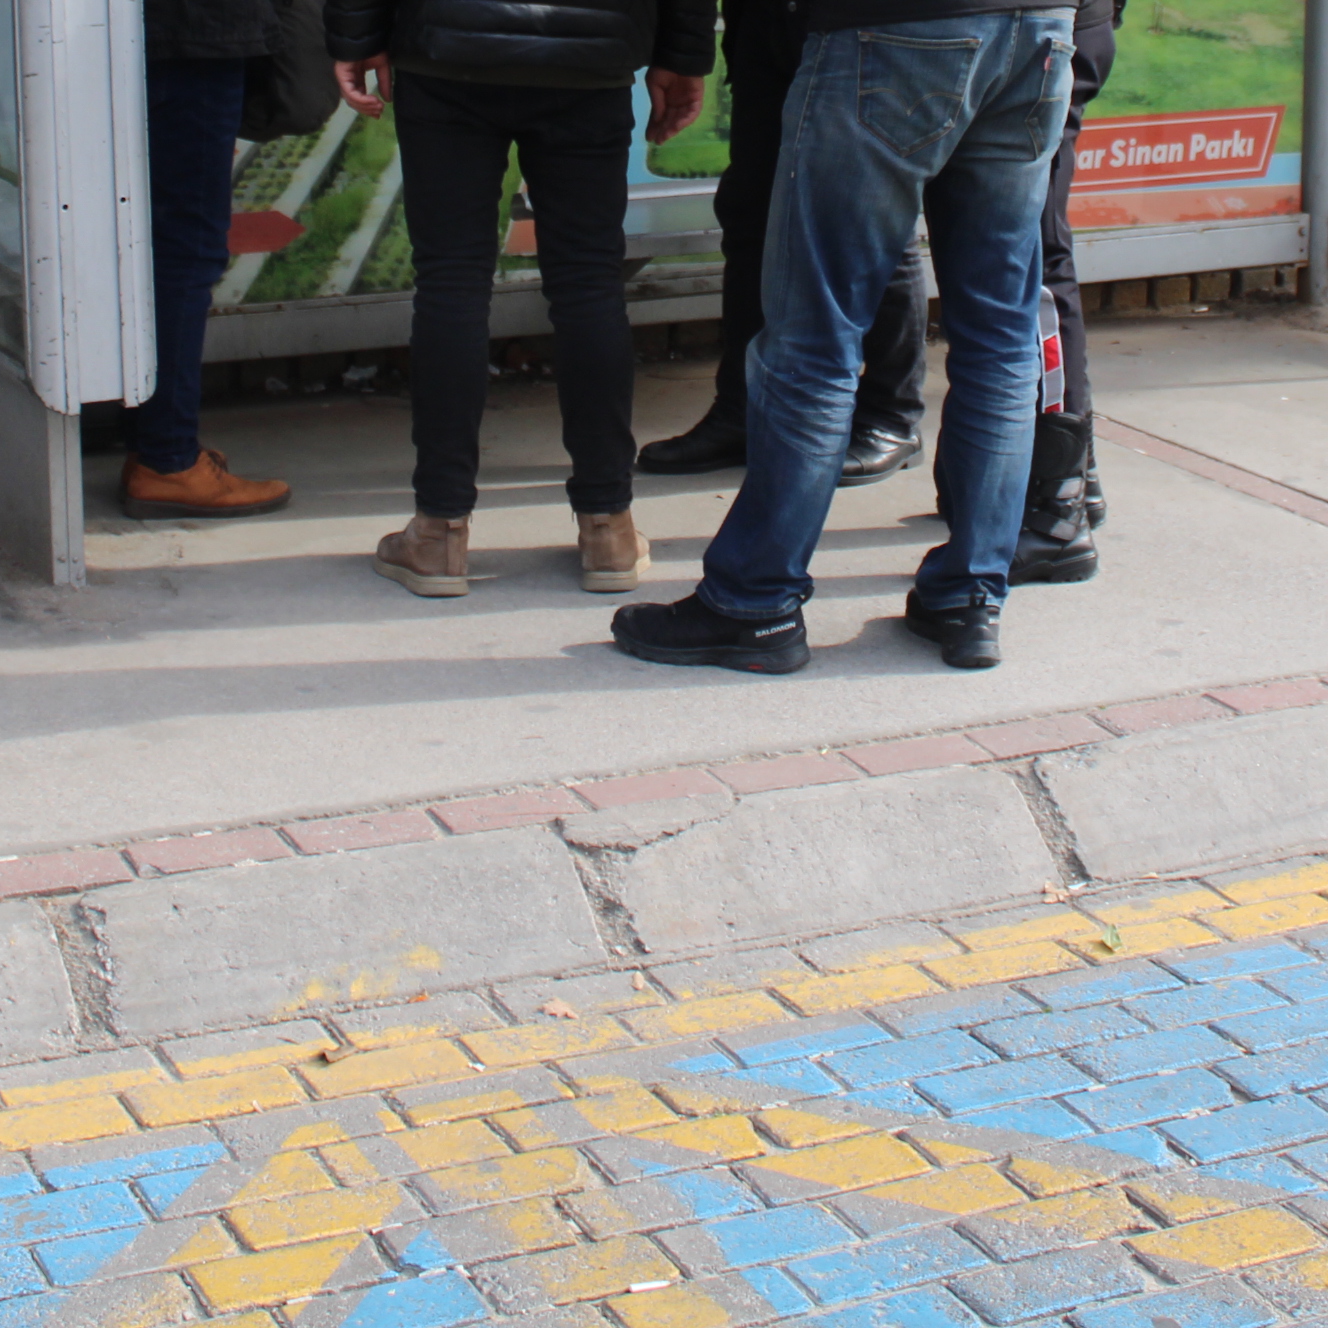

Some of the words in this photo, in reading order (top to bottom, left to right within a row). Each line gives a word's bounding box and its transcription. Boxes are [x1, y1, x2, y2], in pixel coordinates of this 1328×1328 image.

[1075, 149, 1106, 171] ar
[1109, 138, 1184, 168] Sinan
[1188, 130, 1255, 161] Parkı
[755, 621, 797, 638] SALOMON
